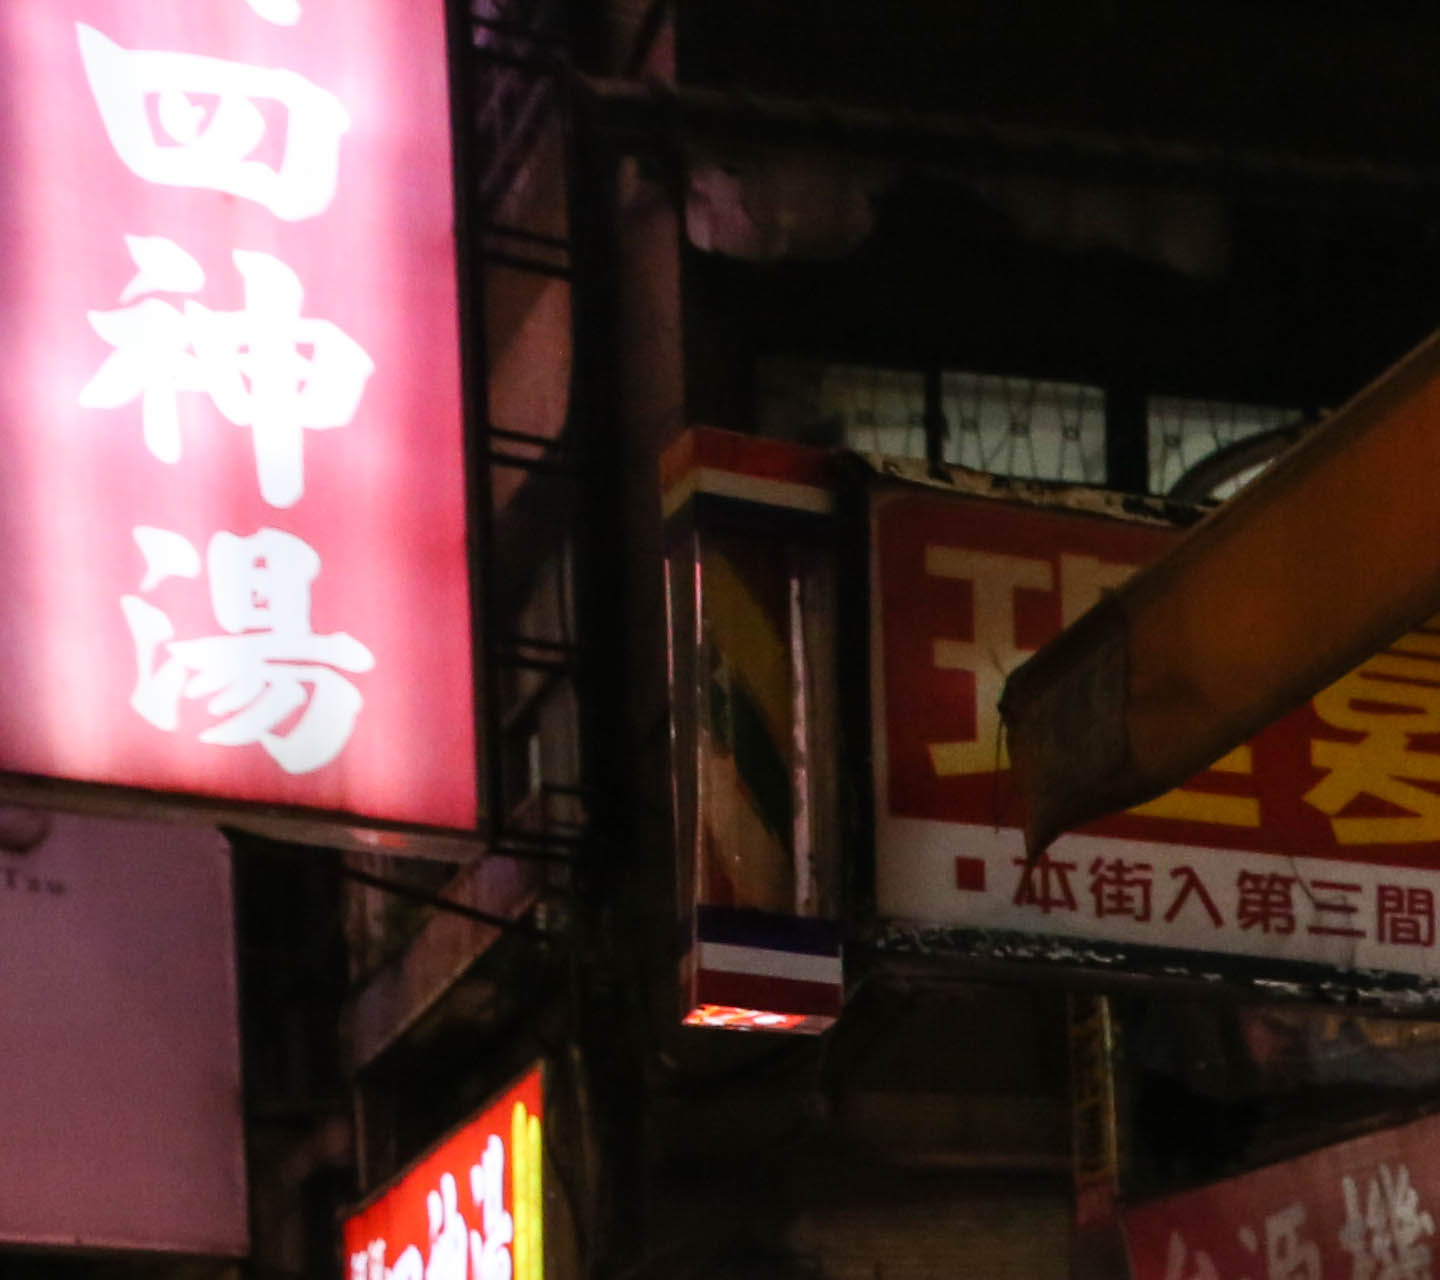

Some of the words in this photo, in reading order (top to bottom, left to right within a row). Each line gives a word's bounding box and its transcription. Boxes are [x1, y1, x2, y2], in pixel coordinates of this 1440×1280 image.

[76, 22, 375, 774] 四神湯
[1011, 855, 1437, 948] 本街入第三間
